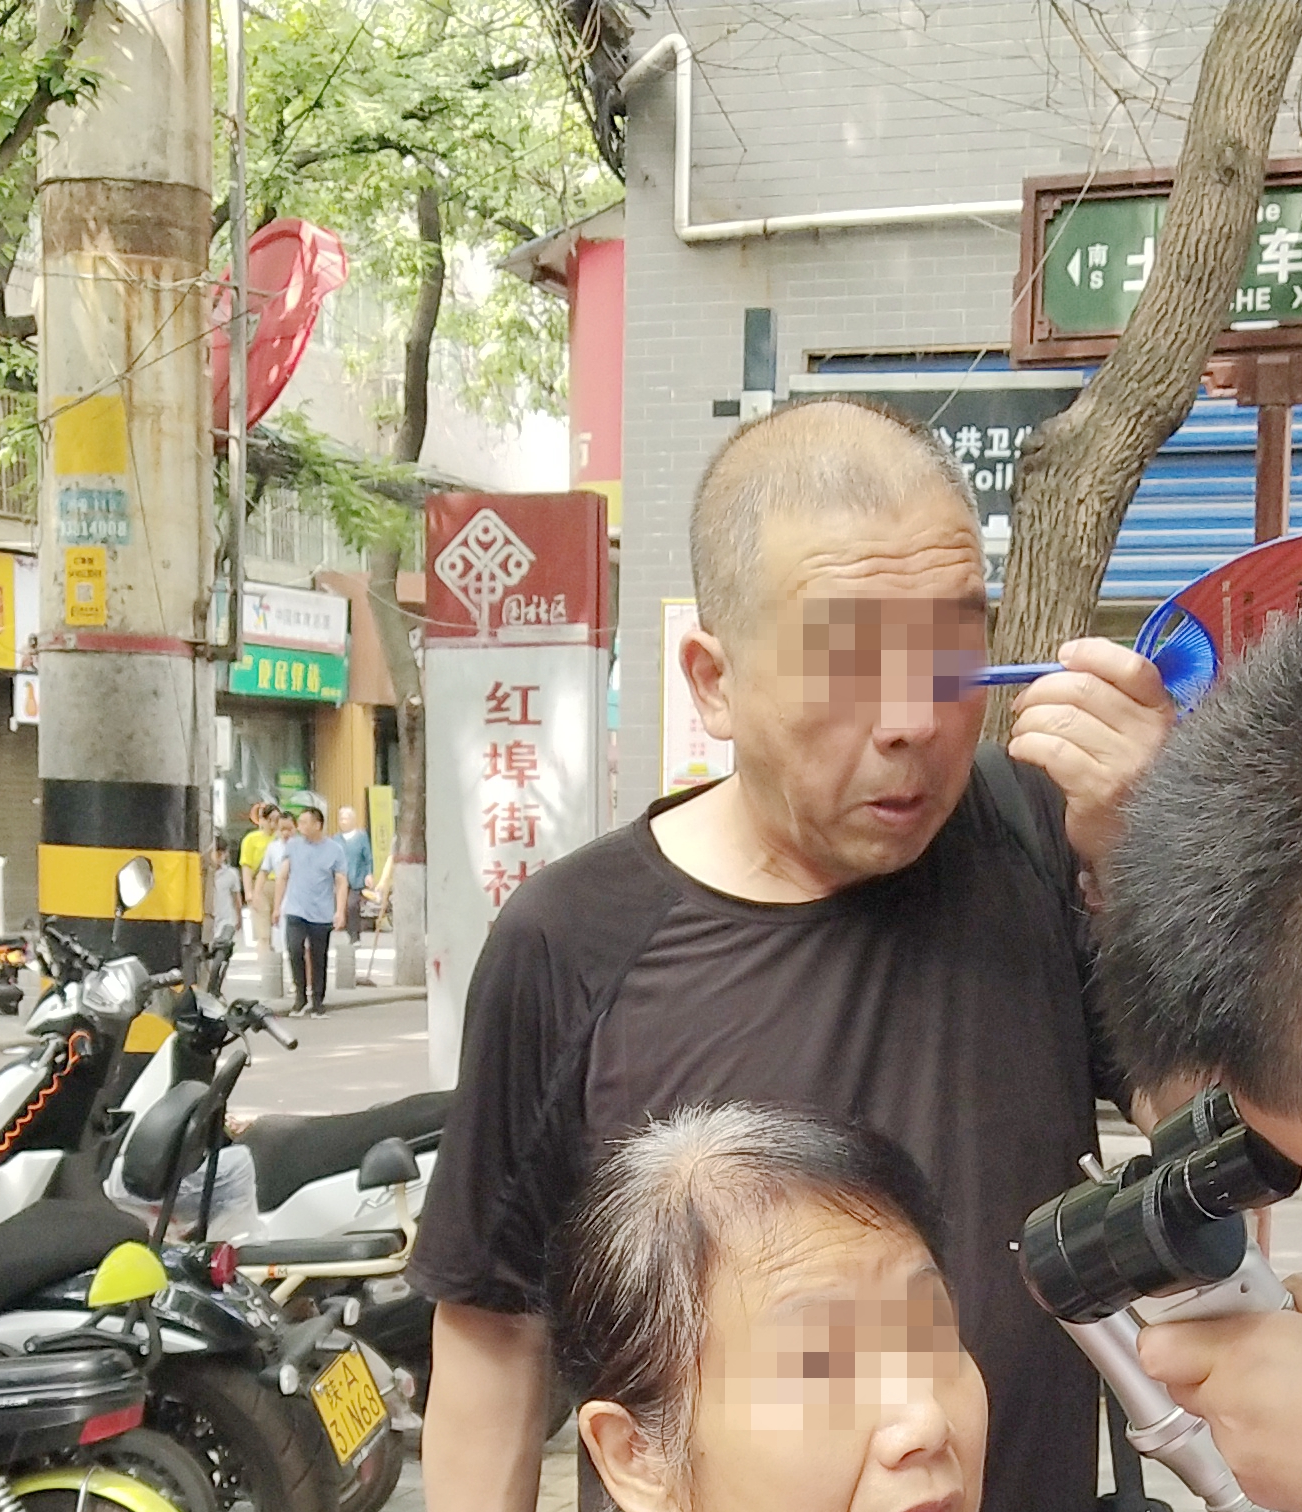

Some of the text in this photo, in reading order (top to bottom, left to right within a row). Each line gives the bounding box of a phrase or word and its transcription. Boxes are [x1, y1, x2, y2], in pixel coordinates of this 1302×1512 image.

[1088, 243, 1109, 268] 南
[1089, 270, 1105, 290] S
[1229, 286, 1272, 314] HE
[481, 680, 546, 932] 红埠街社
[329, 1383, 381, 1455] 31N68
